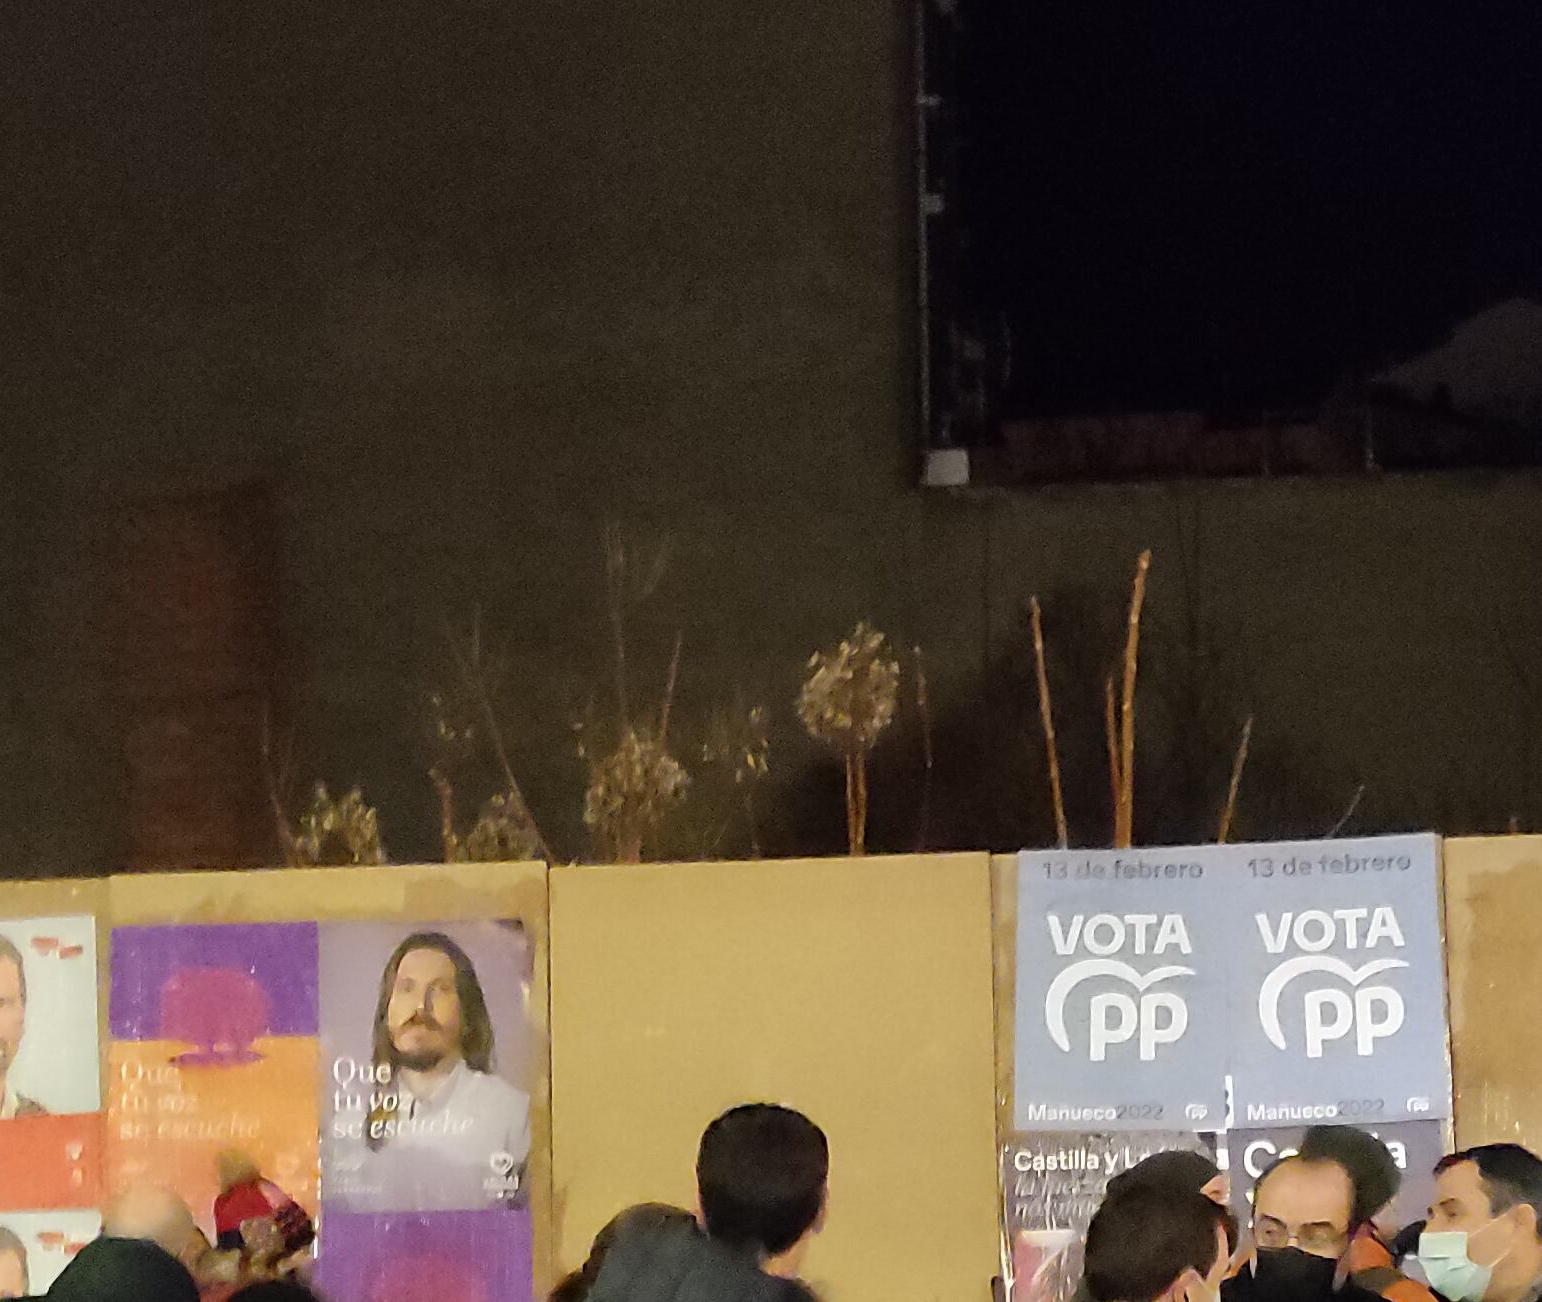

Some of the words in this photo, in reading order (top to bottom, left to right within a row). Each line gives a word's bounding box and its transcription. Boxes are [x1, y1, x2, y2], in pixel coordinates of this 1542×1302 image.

[1042, 861, 1068, 879] 13
[1076, 860, 1107, 879] de
[1114, 859, 1204, 879] febrero
[1247, 857, 1275, 878] 13
[1282, 856, 1312, 876] de
[1318, 854, 1412, 875] febrero
[1047, 913, 1193, 955] VOTA
[1255, 906, 1405, 954] VOTA
[333, 1056, 393, 1089] Que
[370, 1109, 475, 1140] escuche
[1014, 1146, 1100, 1172] Castilla
[1104, 1152, 1119, 1174] y
